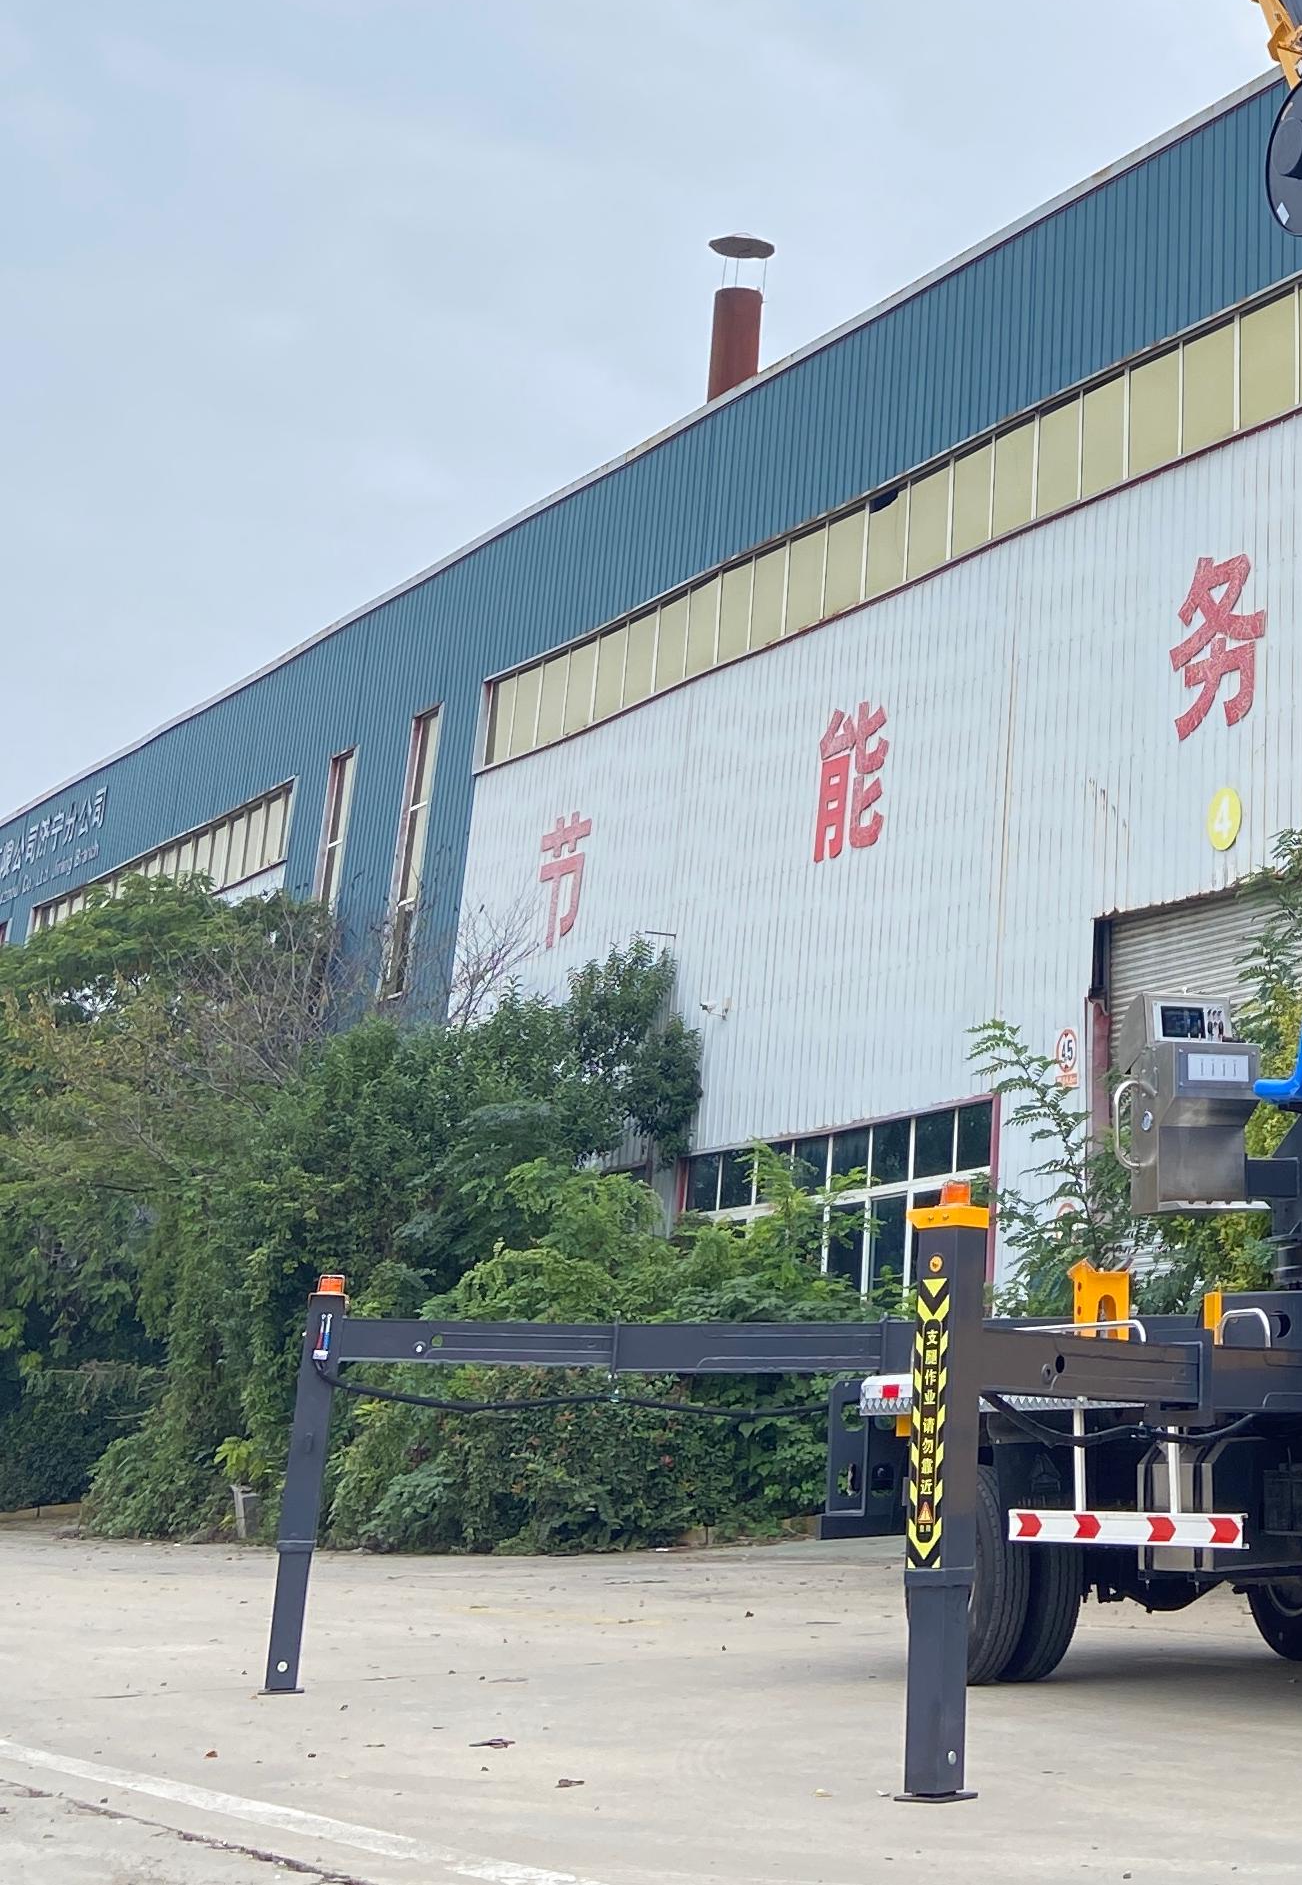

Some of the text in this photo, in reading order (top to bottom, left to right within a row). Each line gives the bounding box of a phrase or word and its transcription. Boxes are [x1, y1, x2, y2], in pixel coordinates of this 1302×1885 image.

[538, 810, 592, 949] 节
[813, 701, 890, 864] 能
[1169, 553, 1265, 741] 务
[920, 1329, 939, 1495] 支腿作业 请勿靠近
